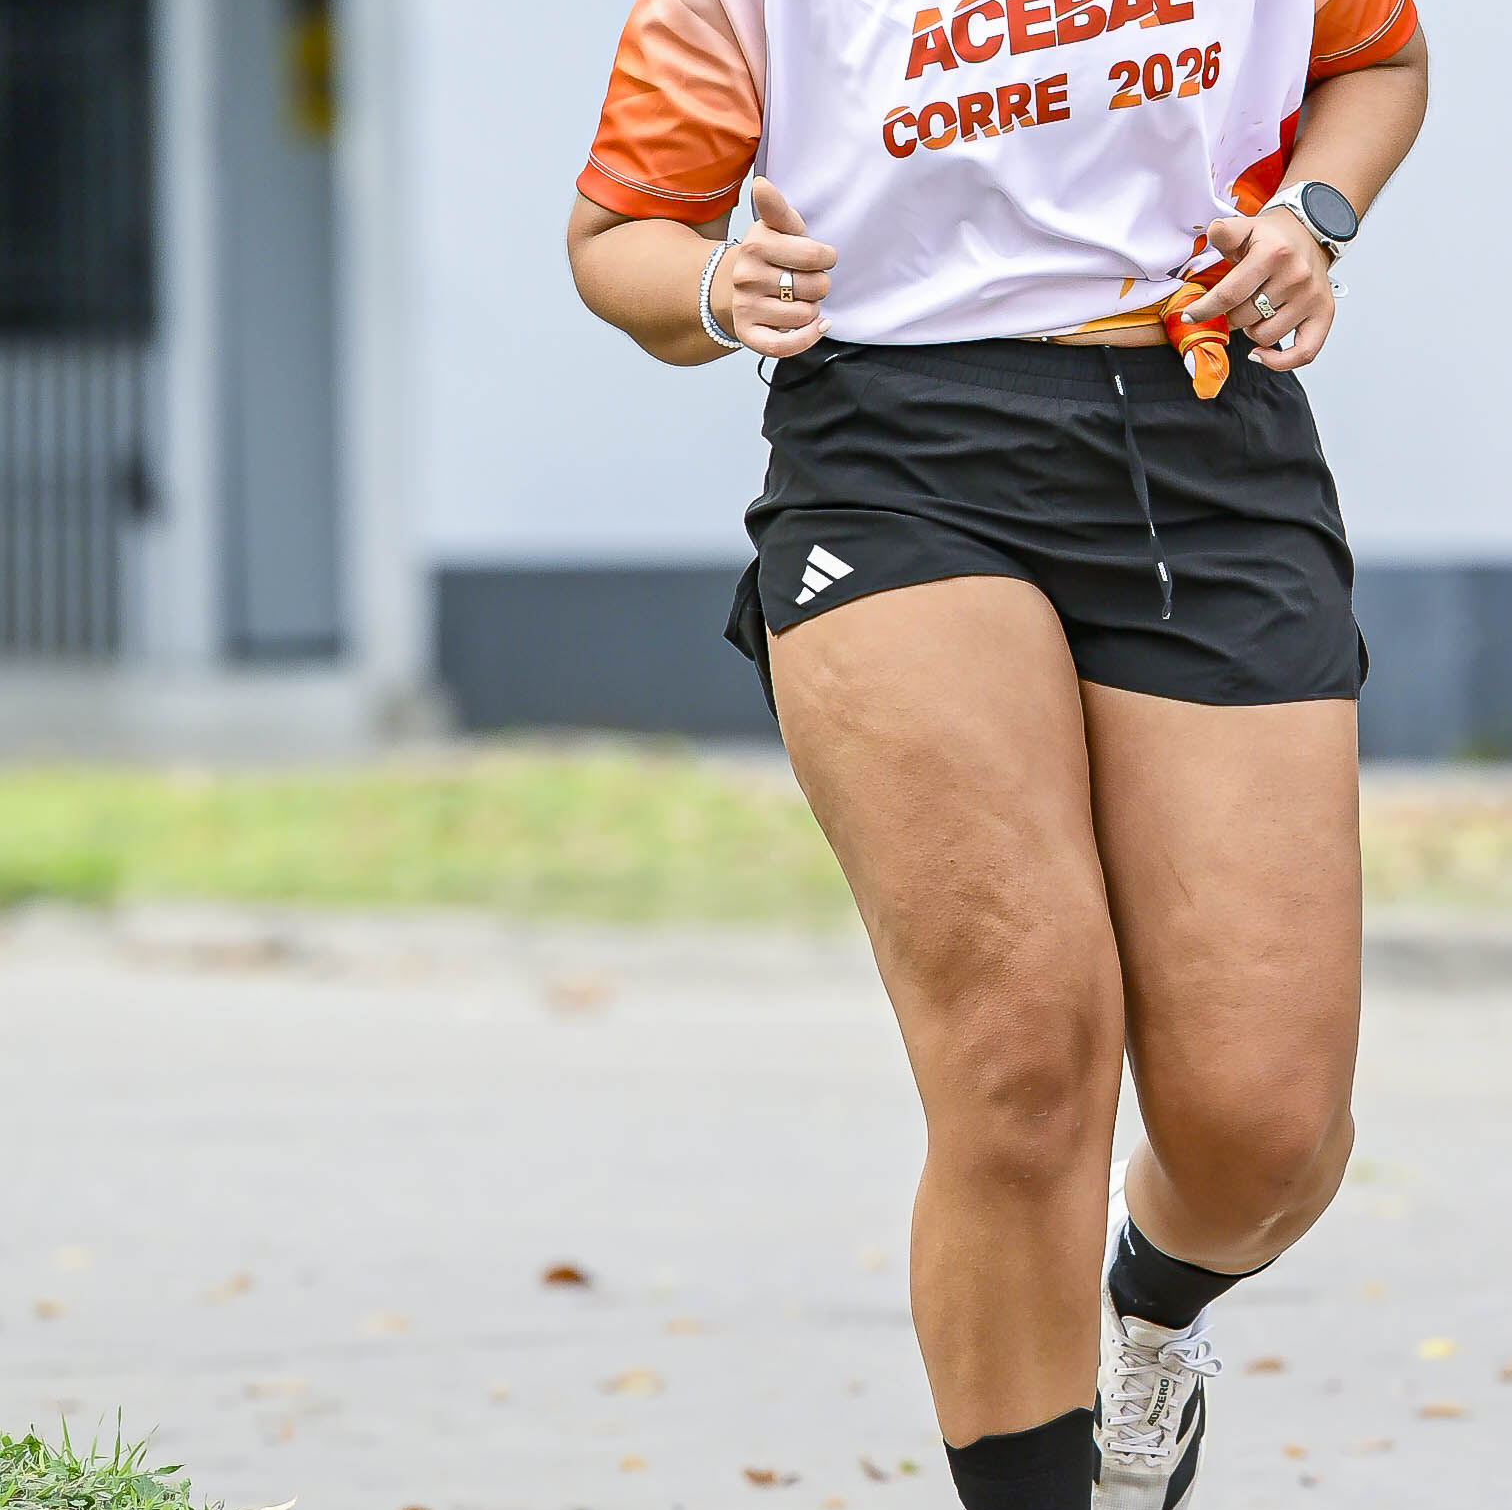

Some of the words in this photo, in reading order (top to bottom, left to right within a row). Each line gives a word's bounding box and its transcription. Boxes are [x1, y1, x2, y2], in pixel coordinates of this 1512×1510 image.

[882, 72, 1071, 159] CORRE
[1107, 40, 1222, 111] 2026
[1147, 1378, 1170, 1427] ADIZERO
